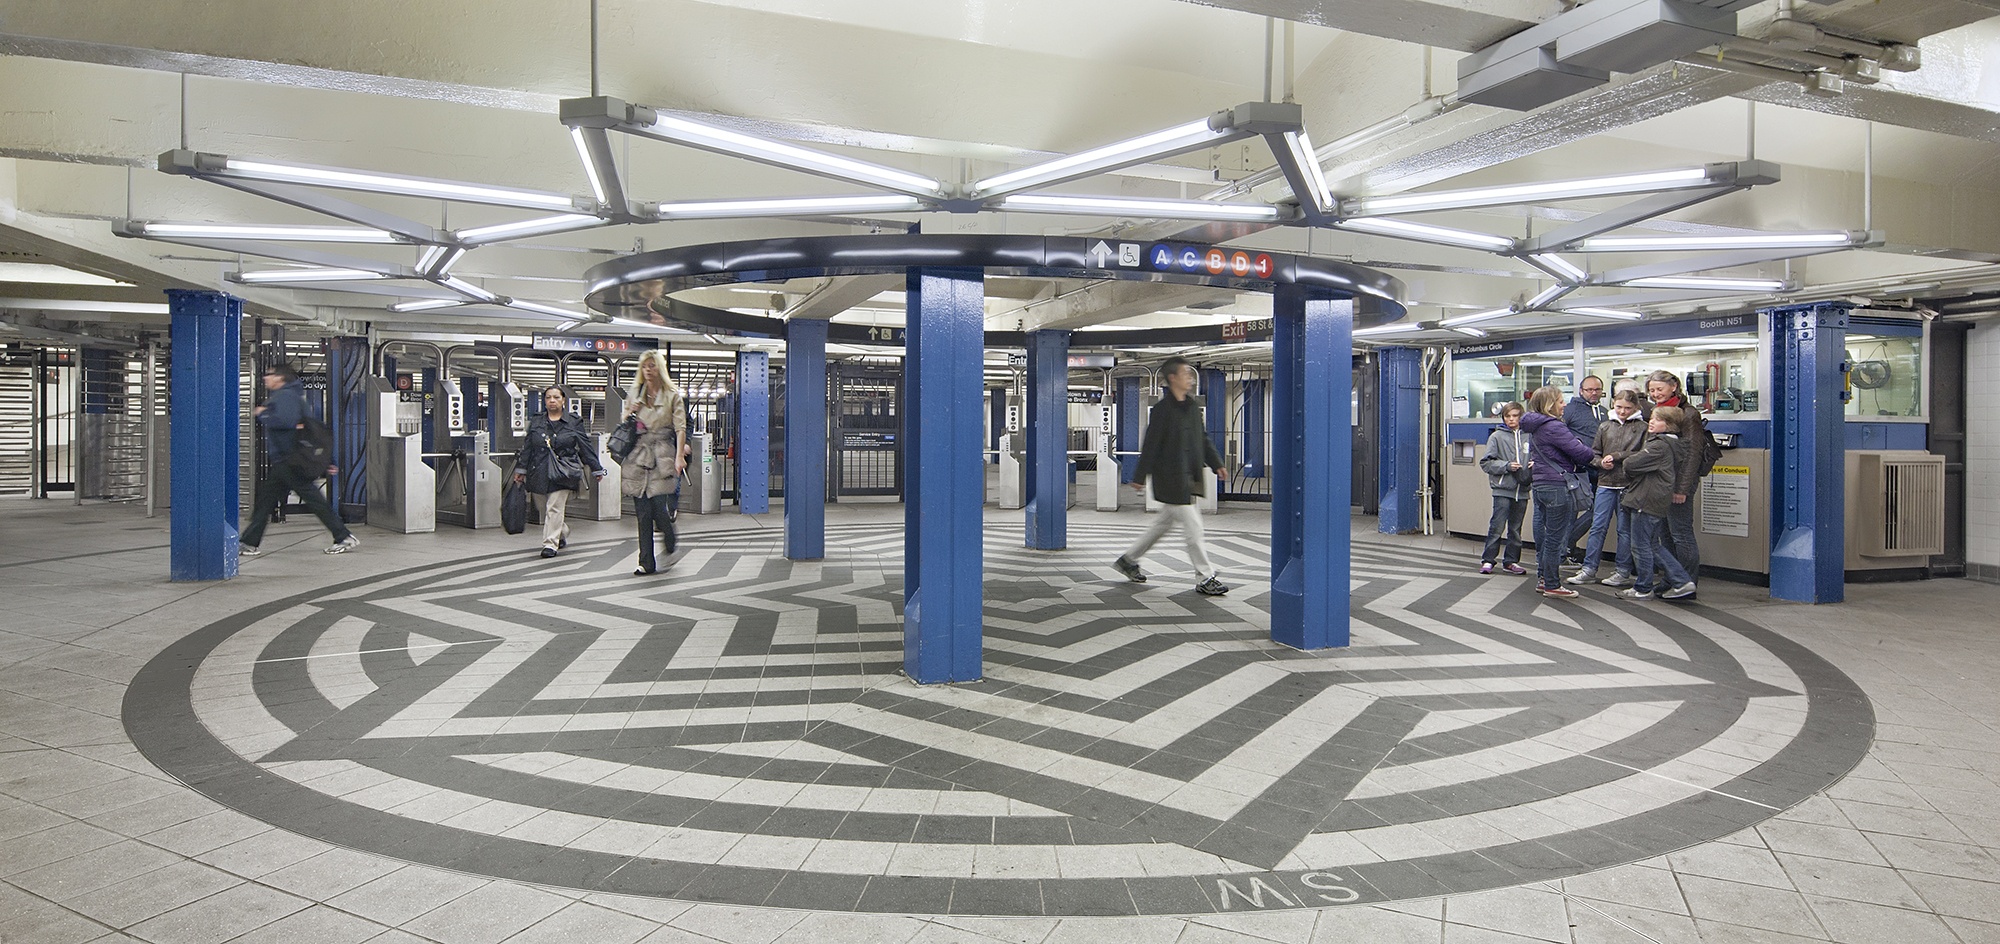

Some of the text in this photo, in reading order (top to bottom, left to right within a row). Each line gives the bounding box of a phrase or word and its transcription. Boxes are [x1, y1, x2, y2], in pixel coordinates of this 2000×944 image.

[1155, 249, 1267, 273] A C B D 1
[1222, 318, 1274, 337] Exit 58 St &
[1700, 316, 1743, 329] Booth N51
[899, 331, 906, 339] A
[534, 336, 566, 349] Entry
[1488, 343, 1503, 351] Circle
[1008, 356, 1028, 365] Entr
[400, 378, 408, 387] D
